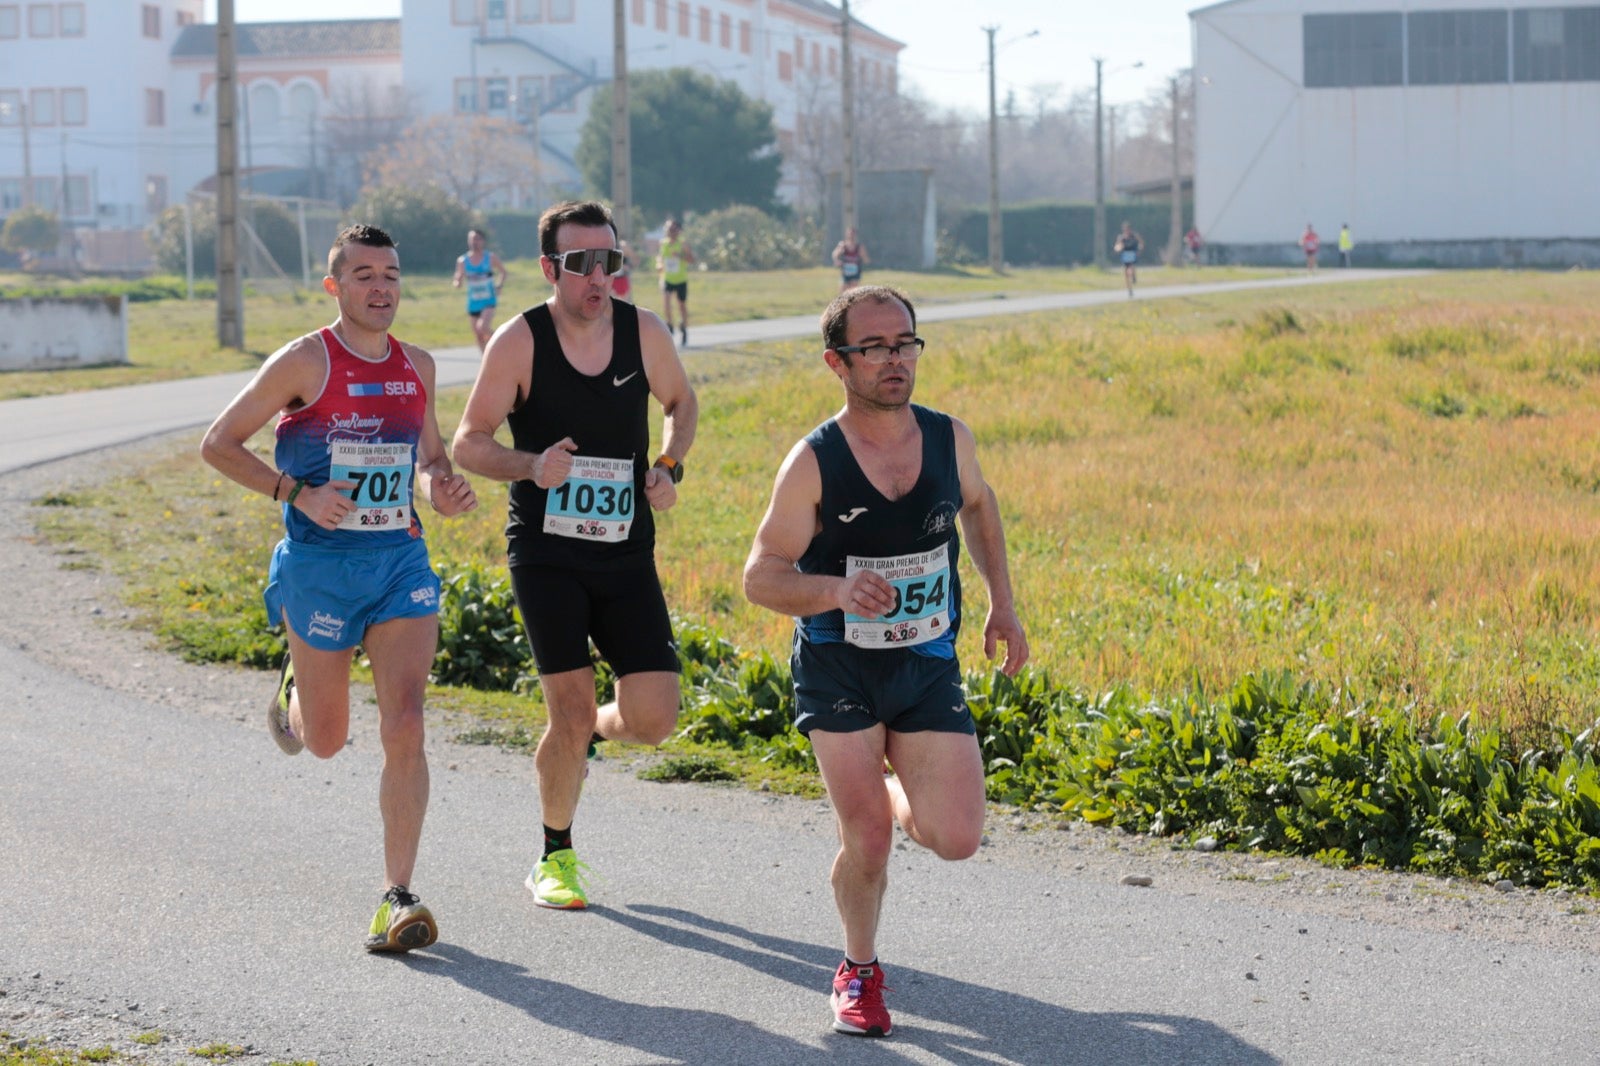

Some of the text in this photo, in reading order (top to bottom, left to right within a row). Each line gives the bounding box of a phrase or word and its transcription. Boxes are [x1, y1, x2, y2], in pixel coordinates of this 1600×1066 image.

[384, 381, 417, 396] SEUR
[358, 446, 373, 455] GRAN
[374, 446, 392, 455] PREMIO
[575, 459, 590, 468] GRAN
[590, 460, 612, 470] PREMIO
[612, 462, 620, 470] DE
[348, 470, 402, 503] 702
[555, 482, 632, 516] 1030
[854, 560, 875, 570] XXXIII
[875, 560, 895, 570] GRAN
[896, 556, 920, 568] PREMIO
[920, 554, 929, 564] DE
[885, 566, 925, 580] DIPUTACIÓN
[882, 574, 945, 619] 054
